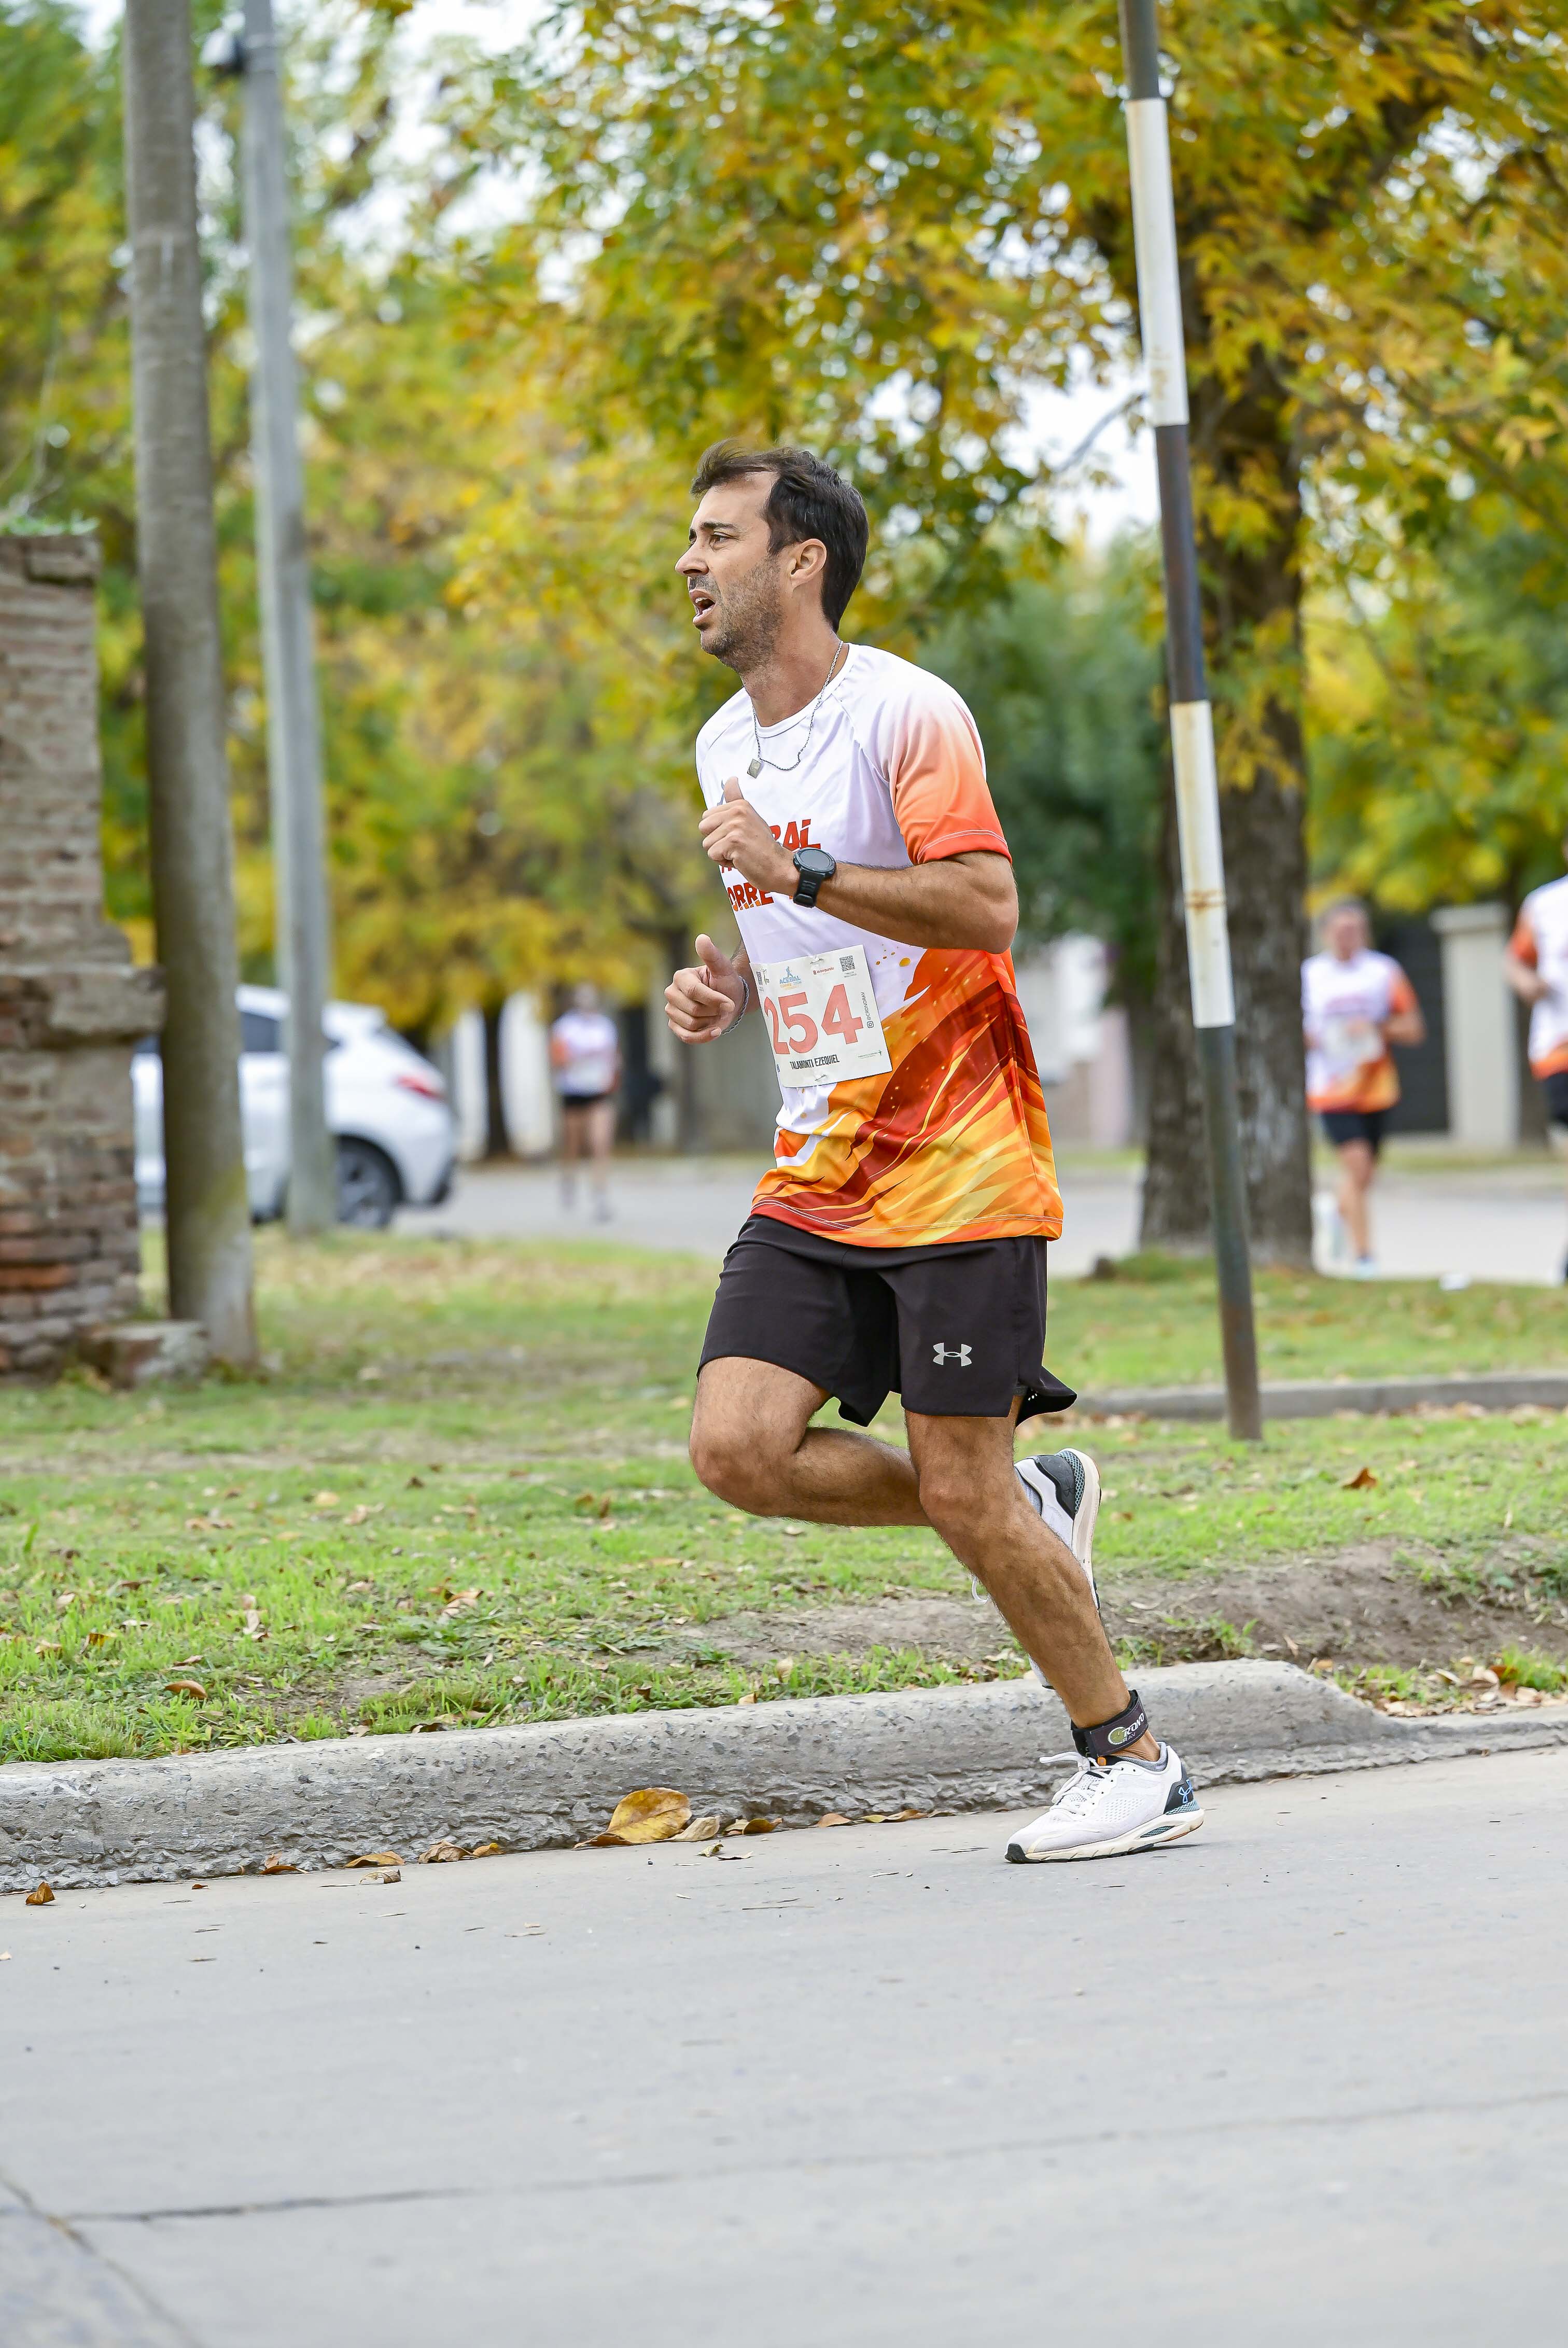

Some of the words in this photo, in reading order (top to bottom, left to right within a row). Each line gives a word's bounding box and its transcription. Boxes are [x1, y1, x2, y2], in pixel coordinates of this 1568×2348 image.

[780, 975, 801, 984] ACEBAL
[764, 984, 863, 1054] 254
[790, 1059, 814, 1070] TALAMONTI
[814, 1054, 839, 1067] EZEQUIEL
